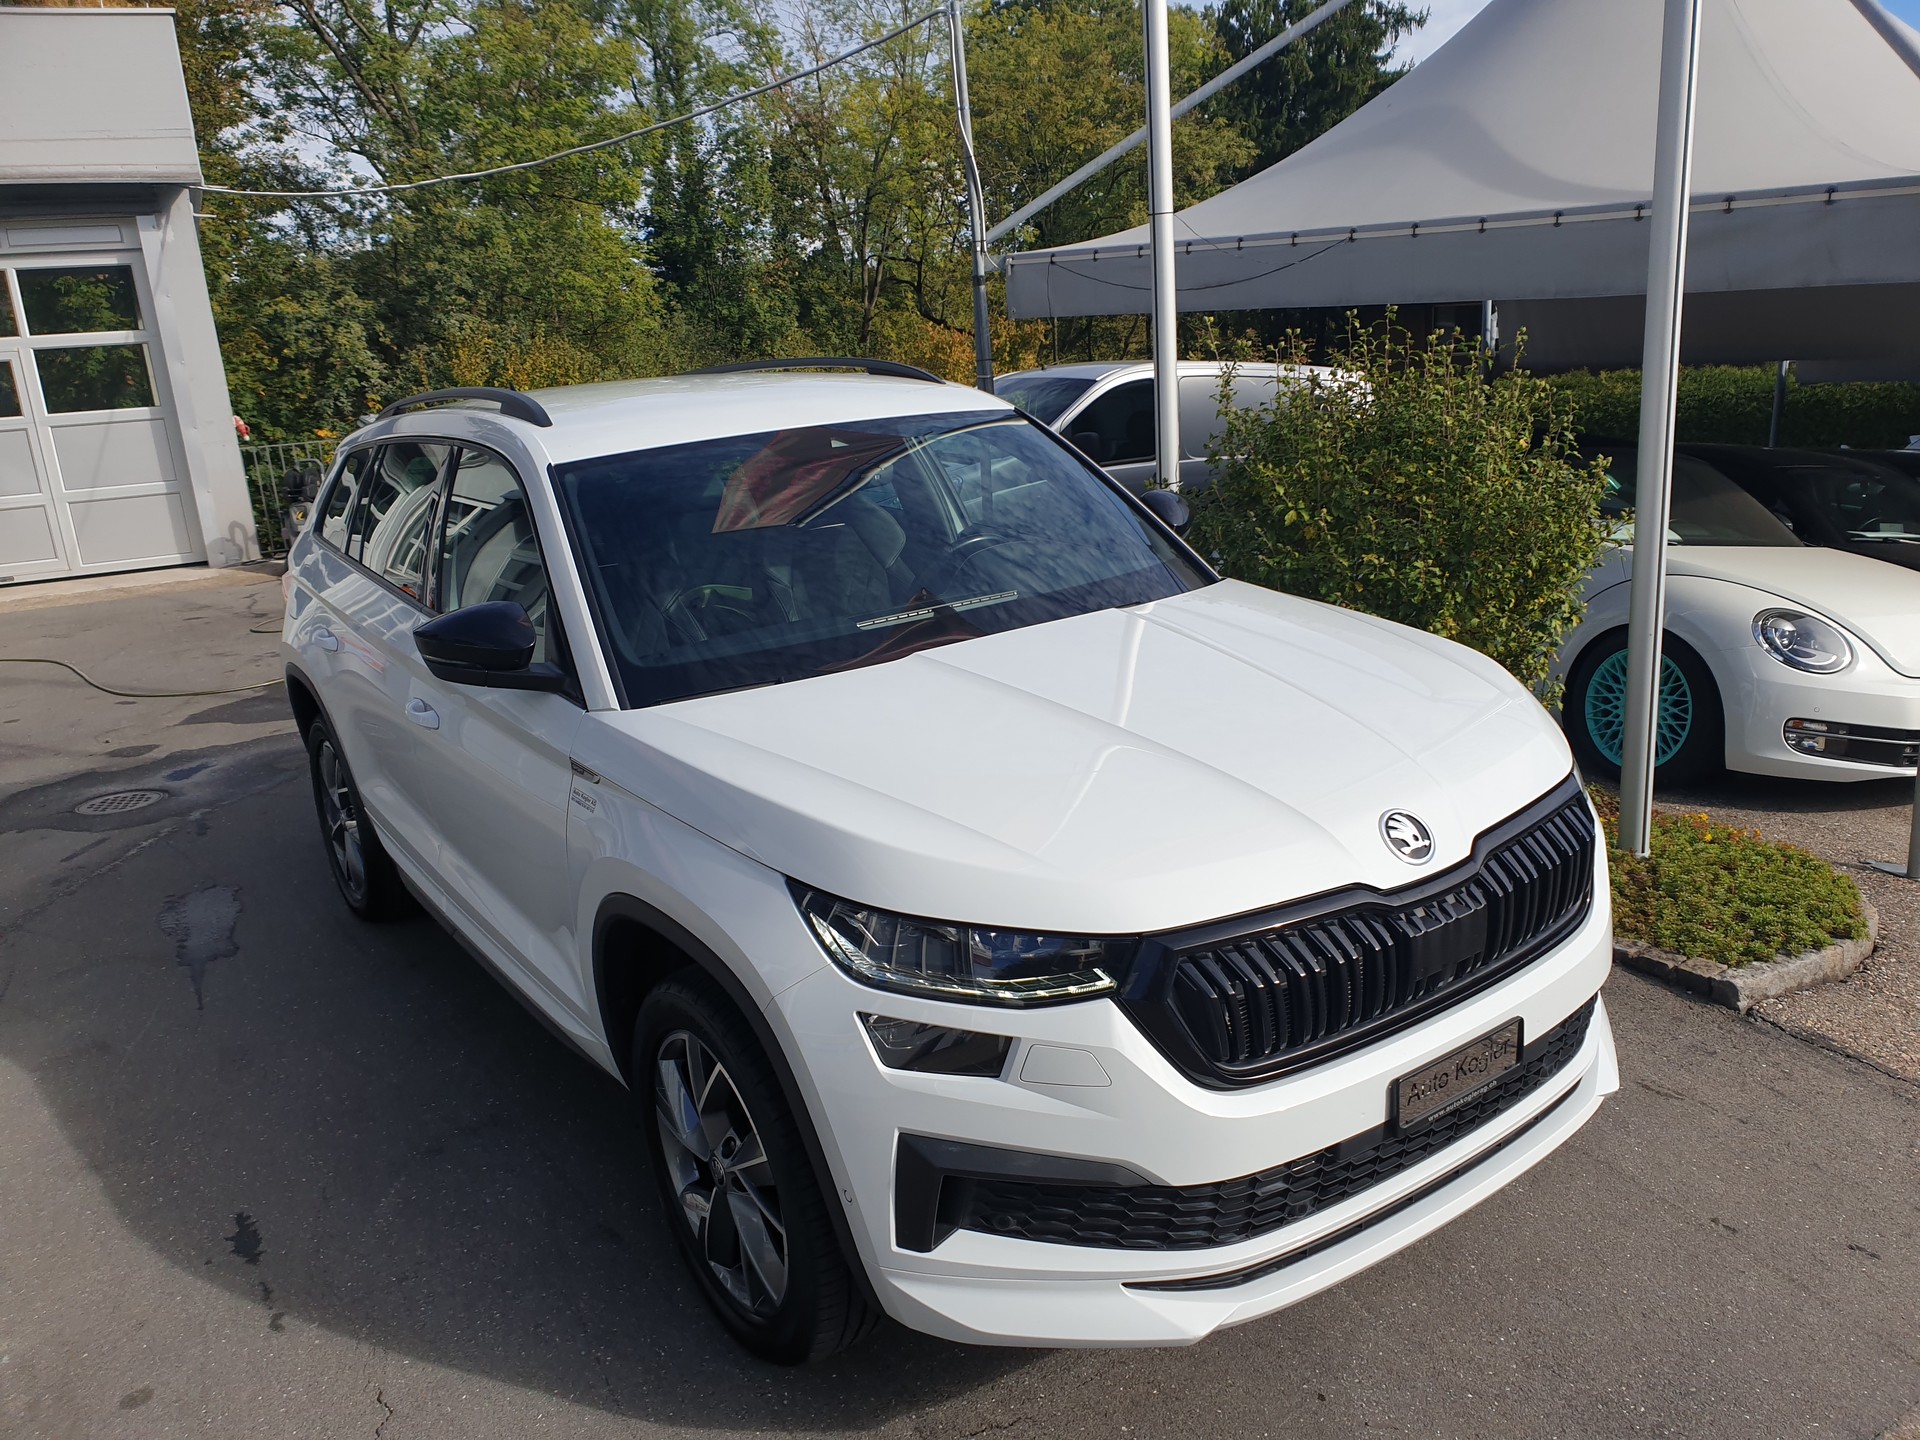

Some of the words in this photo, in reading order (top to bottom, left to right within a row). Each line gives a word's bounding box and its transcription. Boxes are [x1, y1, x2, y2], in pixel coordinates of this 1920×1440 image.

[1407, 1072, 1449, 1106] Auto
[1455, 1039, 1510, 1080] Kogler
[1428, 1080, 1497, 1122] www.autokoglerag.ch
